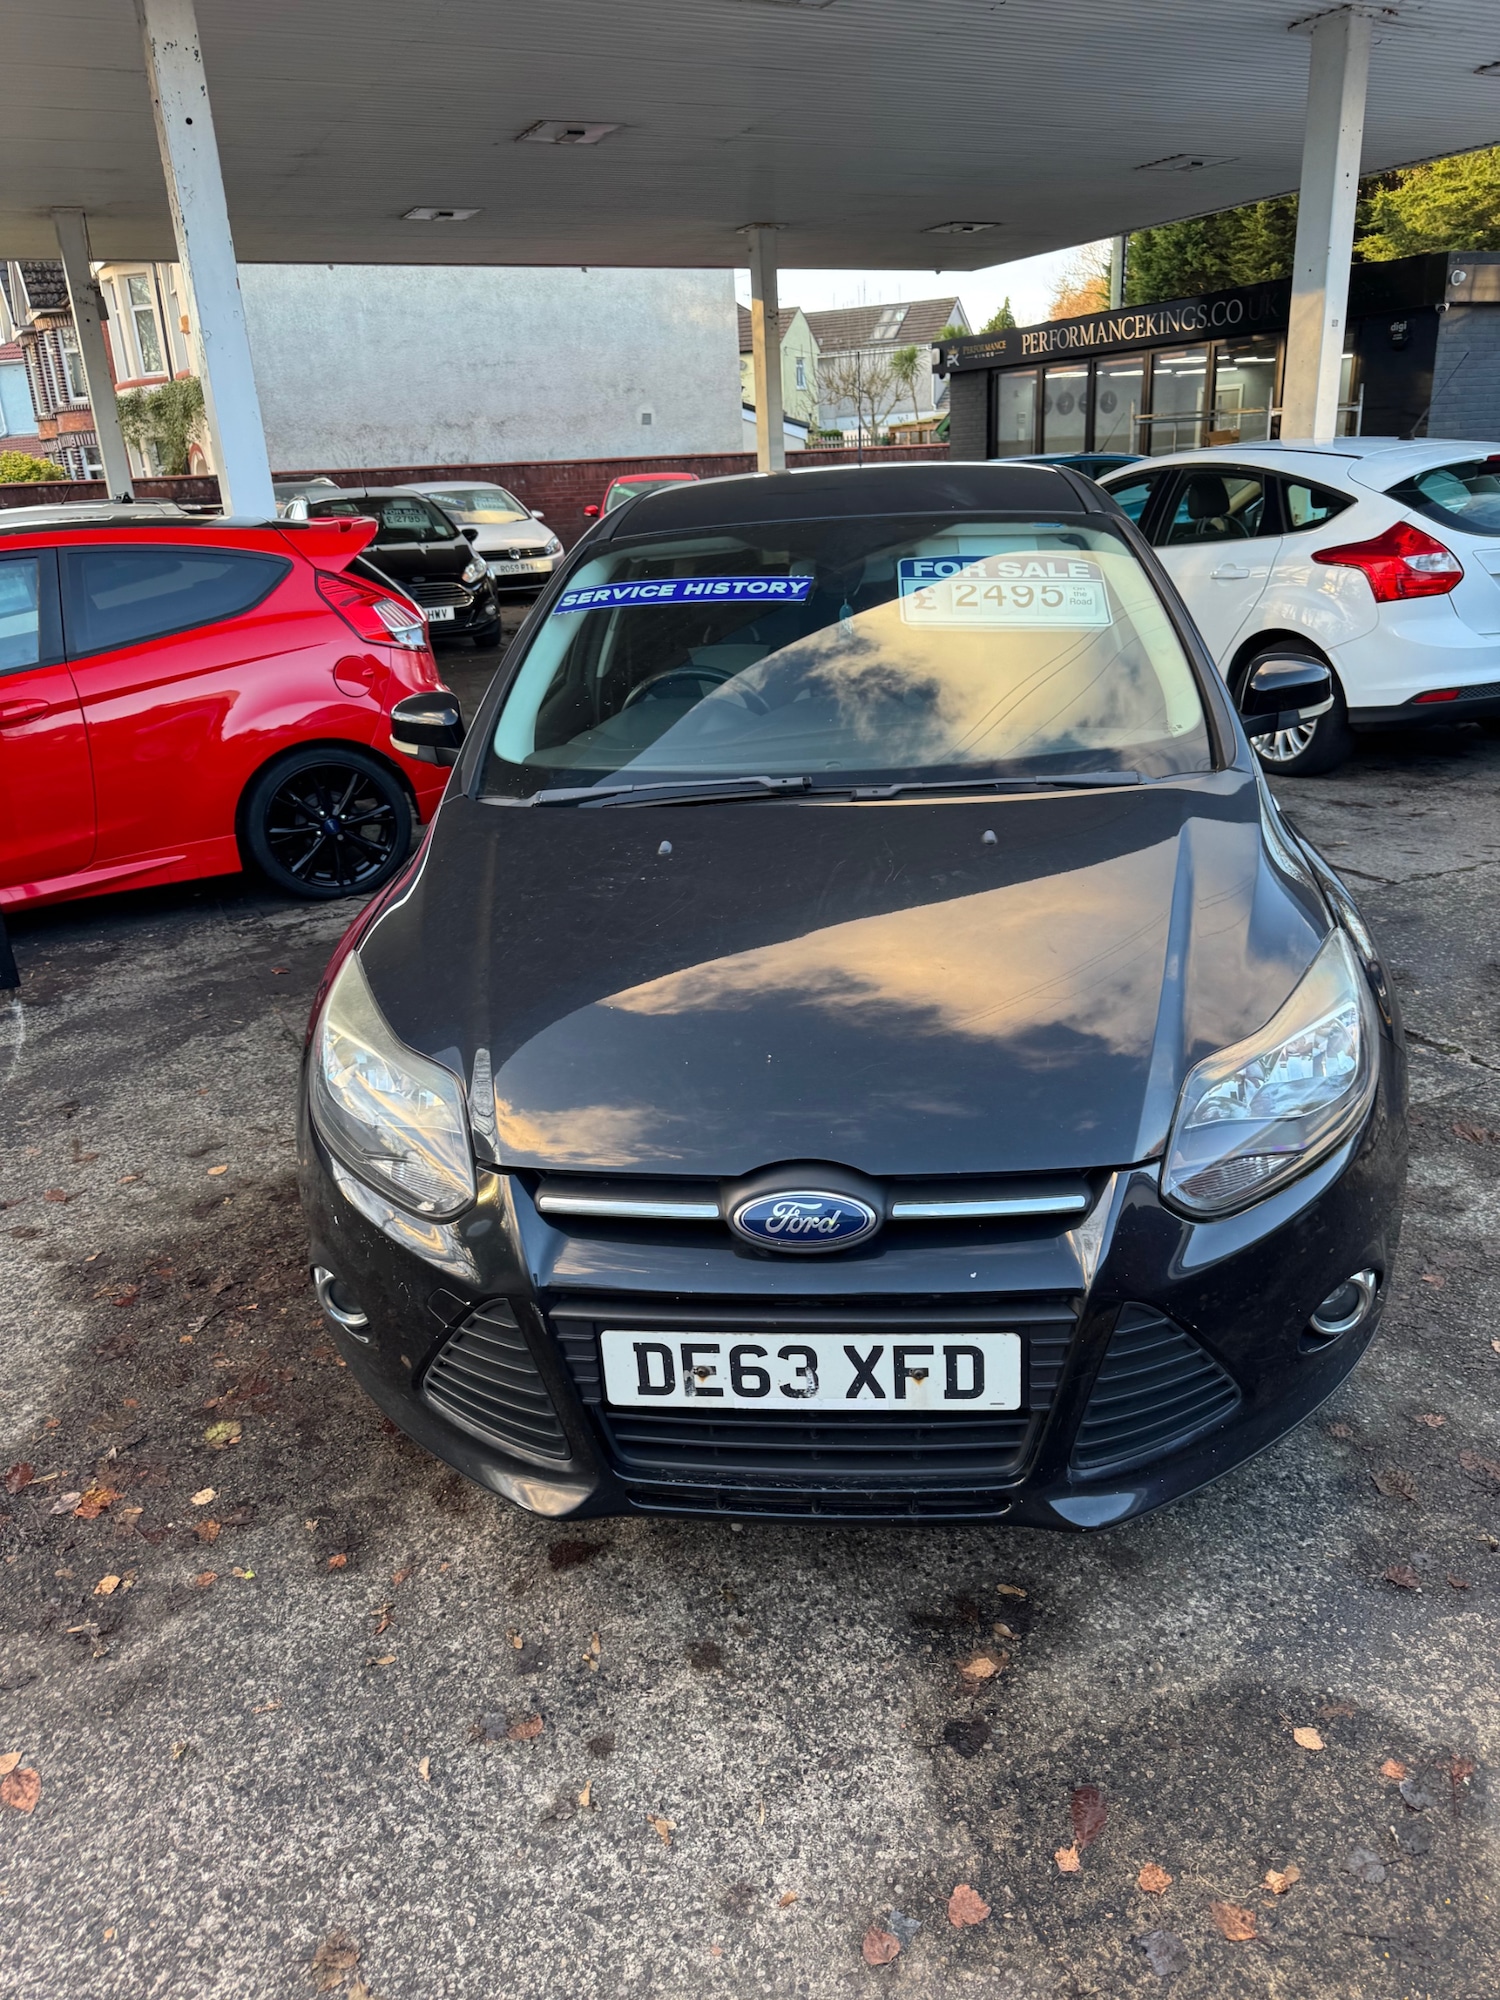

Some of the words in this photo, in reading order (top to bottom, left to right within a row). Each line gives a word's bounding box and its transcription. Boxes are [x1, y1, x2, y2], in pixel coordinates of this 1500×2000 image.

[1390, 320, 1408, 333] digi
[962, 340, 1007, 355] PERFORMANCE
[913, 561, 986, 577] FOR
[998, 562, 1091, 578] SALE
[560, 584, 677, 608] SERVICE
[683, 581, 809, 596] HISTORY
[954, 584, 1064, 608] 2495
[1069, 598, 1093, 606] Road
[765, 1201, 841, 1234] Ford
[633, 1342, 819, 1399] DE63
[843, 1345, 985, 1400] XFD
